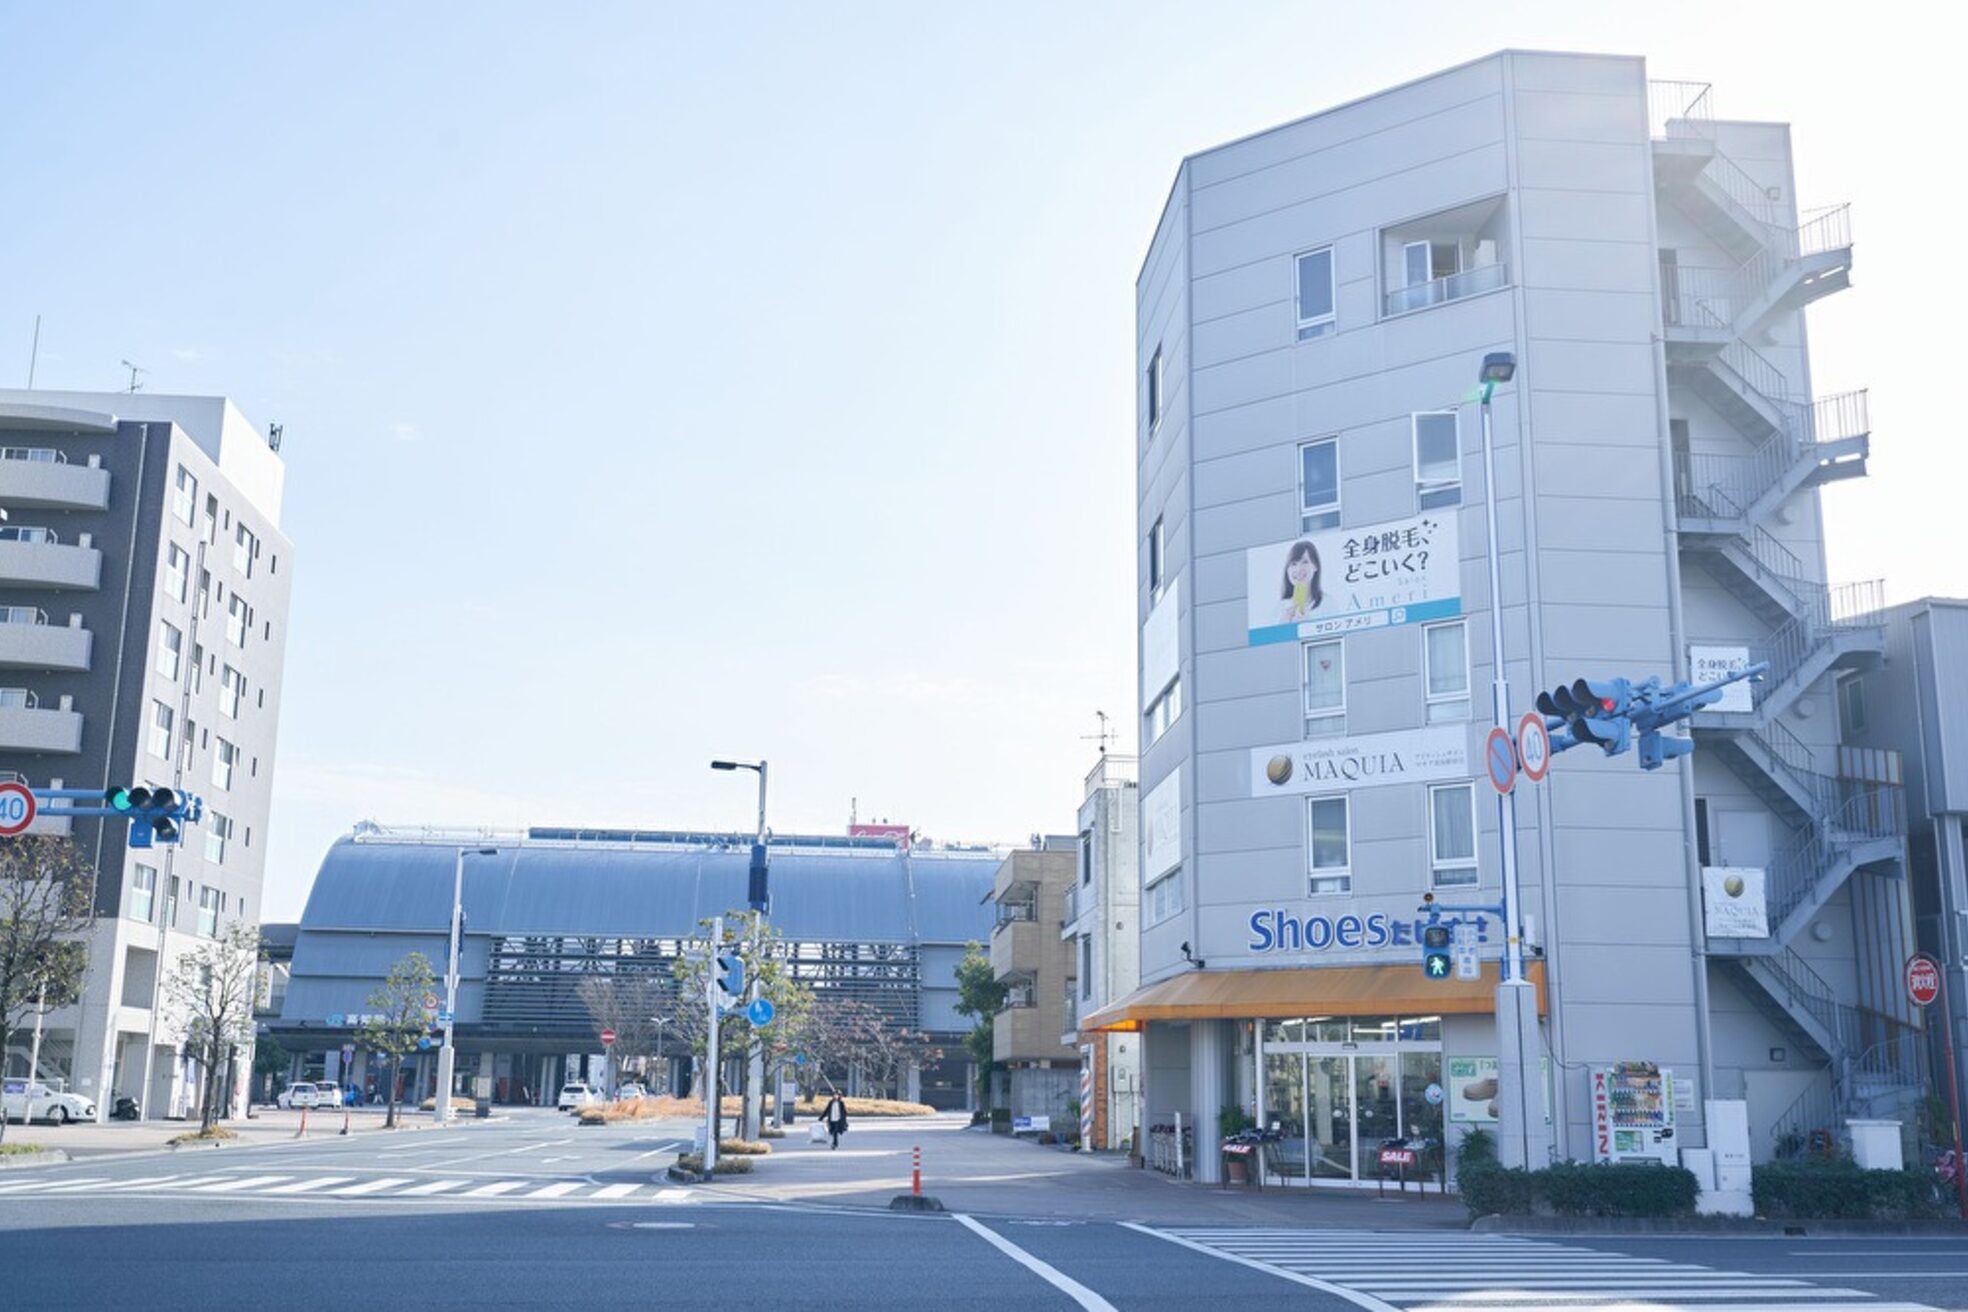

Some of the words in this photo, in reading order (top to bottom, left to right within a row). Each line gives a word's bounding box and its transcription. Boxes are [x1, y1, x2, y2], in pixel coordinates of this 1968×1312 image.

[1344, 551, 1429, 584] どこいく?
[1346, 584, 1429, 611] Ameri
[1315, 620, 1342, 633] サロン
[1525, 731, 1543, 761] 40
[1303, 751, 1406, 781] MAQUIA
[1249, 910, 1388, 951] Shoes
[1381, 1150, 1413, 1163] SALE
